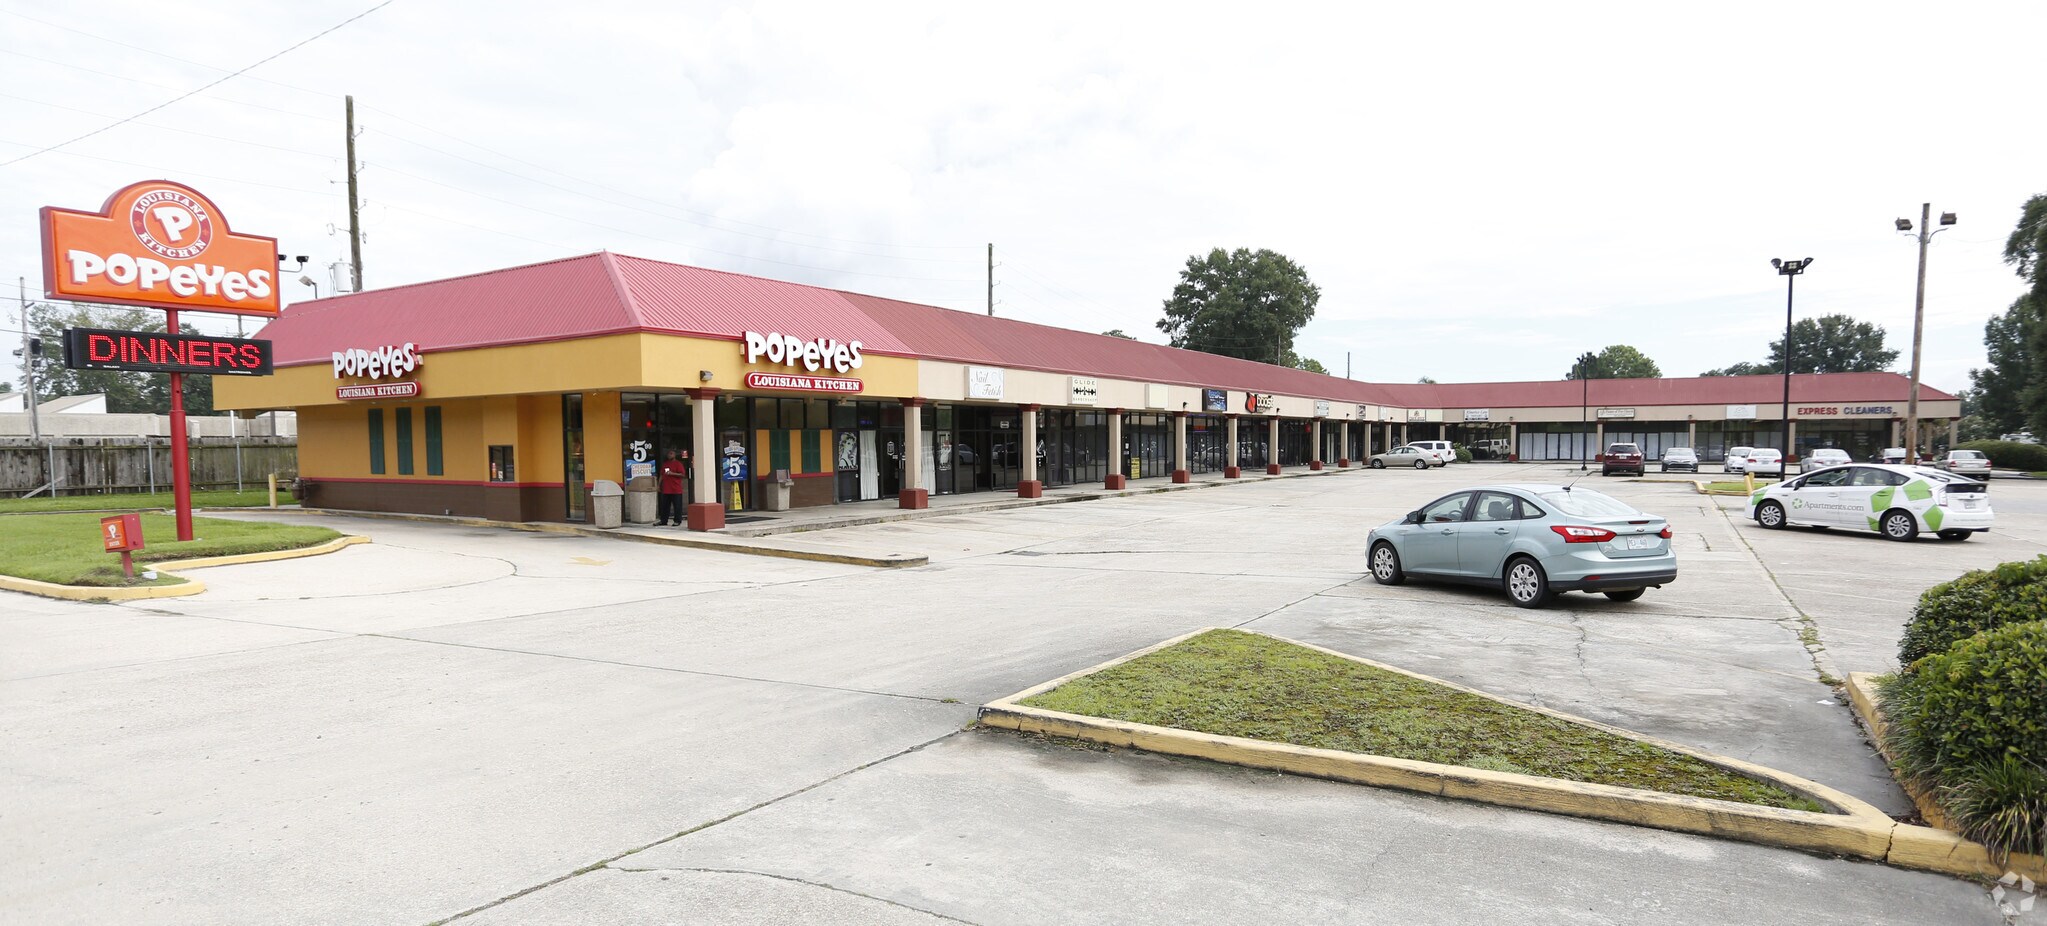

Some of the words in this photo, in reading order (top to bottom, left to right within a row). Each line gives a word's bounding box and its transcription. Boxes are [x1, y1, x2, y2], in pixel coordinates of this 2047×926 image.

[134, 191, 207, 222] LOUISIANA
[153, 206, 193, 242] P
[139, 233, 207, 258] KITCHEN
[68, 249, 271, 301] POPEYES
[89, 334, 262, 369] DINNERS
[332, 342, 415, 380] POPEYES
[744, 330, 863, 374] POPEYES
[753, 375, 812, 389] LOUISIANA
[814, 379, 860, 391] KITCHEN
[971, 371, 989, 383] Nail
[338, 387, 376, 398] LOUISIANA
[377, 385, 413, 396] KITCHEN
[1797, 407, 1838, 415] EXPRESS
[1843, 406, 1893, 415] CLEANERS
[1804, 501, 1865, 511] Apartments.com
